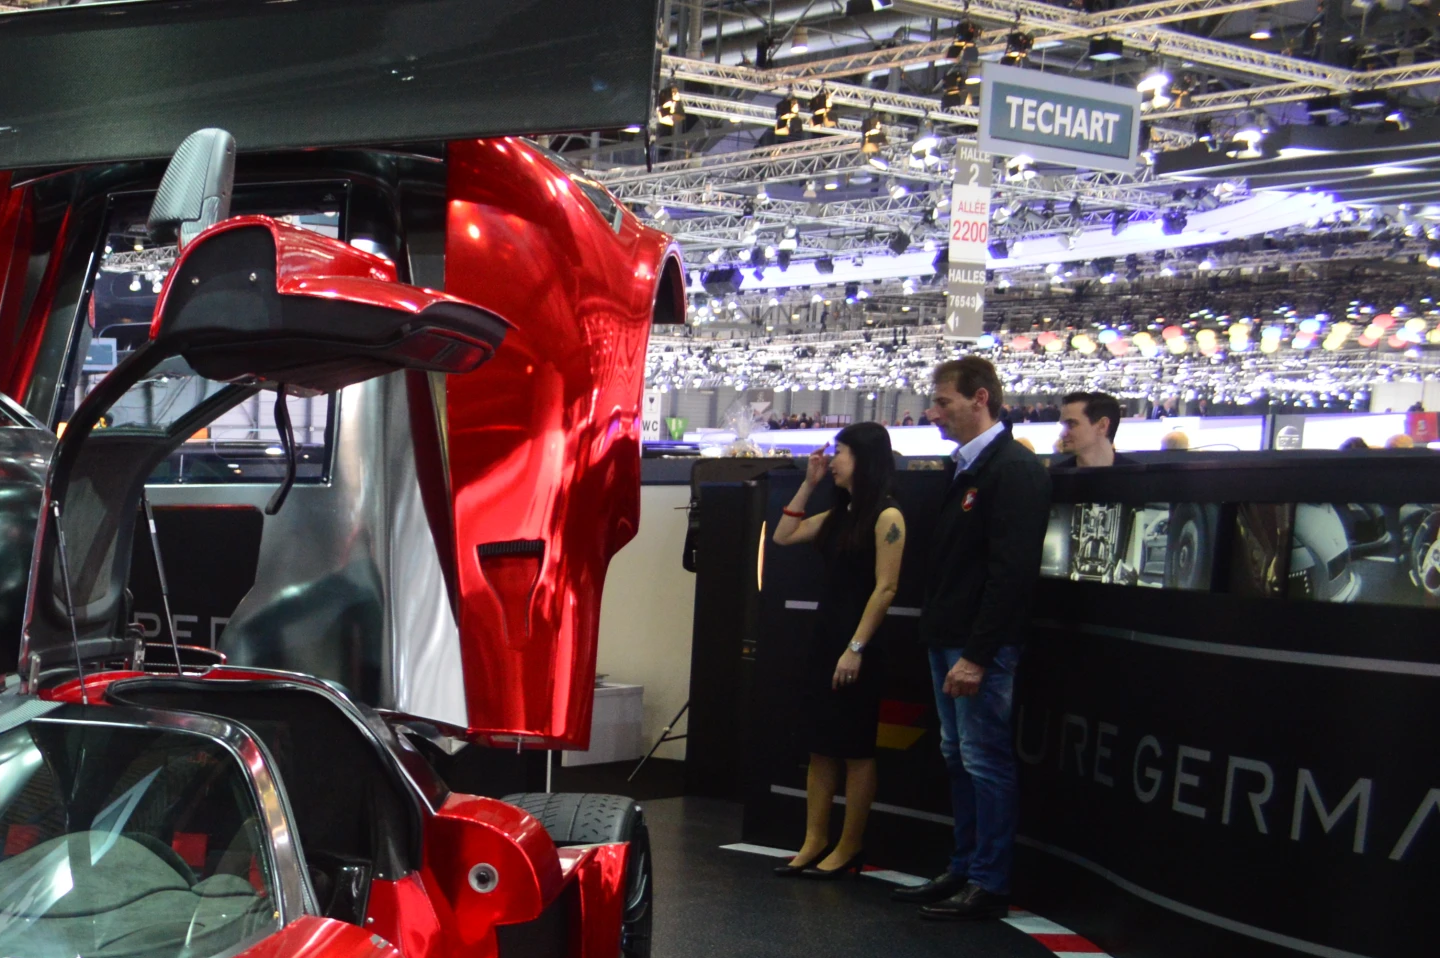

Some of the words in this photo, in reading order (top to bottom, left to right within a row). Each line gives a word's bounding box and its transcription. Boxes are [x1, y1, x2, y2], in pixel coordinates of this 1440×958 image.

[1006, 95, 1120, 144] TECHART
[960, 147, 990, 162] HALLE
[969, 164, 979, 186] 2
[957, 199, 986, 215] ALLÉE
[952, 220, 987, 243] 2200
[948, 268, 986, 285] HALLES
[642, 421, 658, 431] WC
